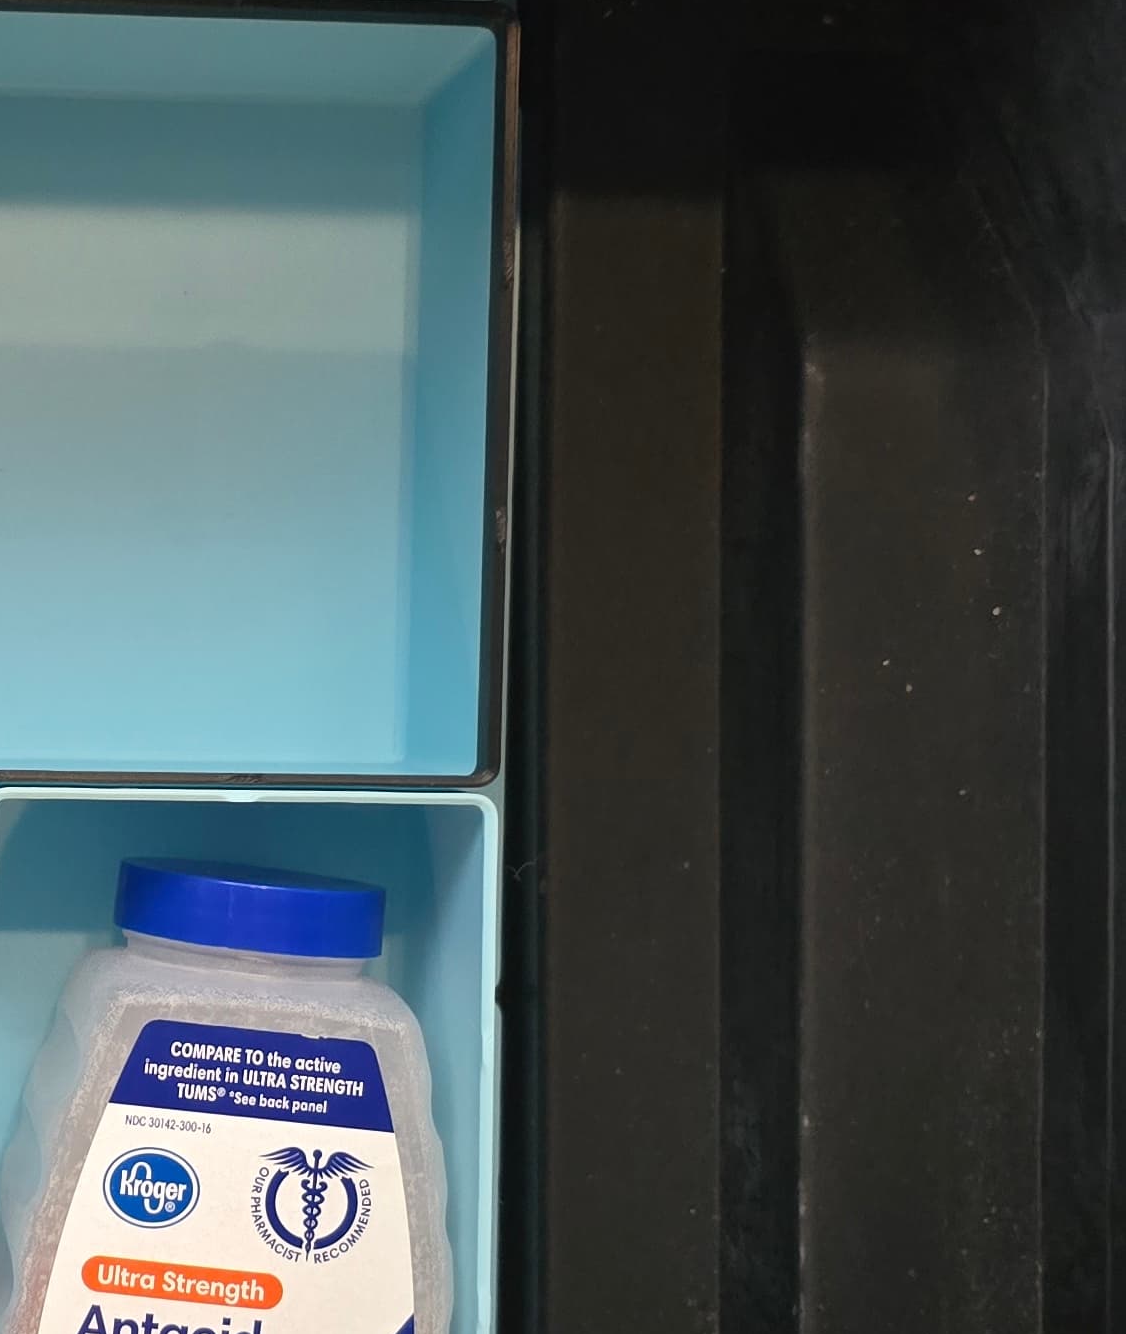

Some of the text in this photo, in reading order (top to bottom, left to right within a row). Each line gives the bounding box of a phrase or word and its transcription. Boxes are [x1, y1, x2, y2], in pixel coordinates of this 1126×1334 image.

[171, 1041, 341, 1074] COMPARE TO the active
[144, 1058, 363, 1097] ingredient in ULTRA STRENGTH
[259, 1094, 289, 1110] back
[291, 1100, 327, 1114] panel
[125, 1115, 212, 1134] NDC 30142-300-16
[120, 1161, 187, 1214] Kroger
[251, 1167, 372, 1264] OUR PHARMACIST RECOMMENDED
[97, 1264, 264, 1304] Ultra Strength
